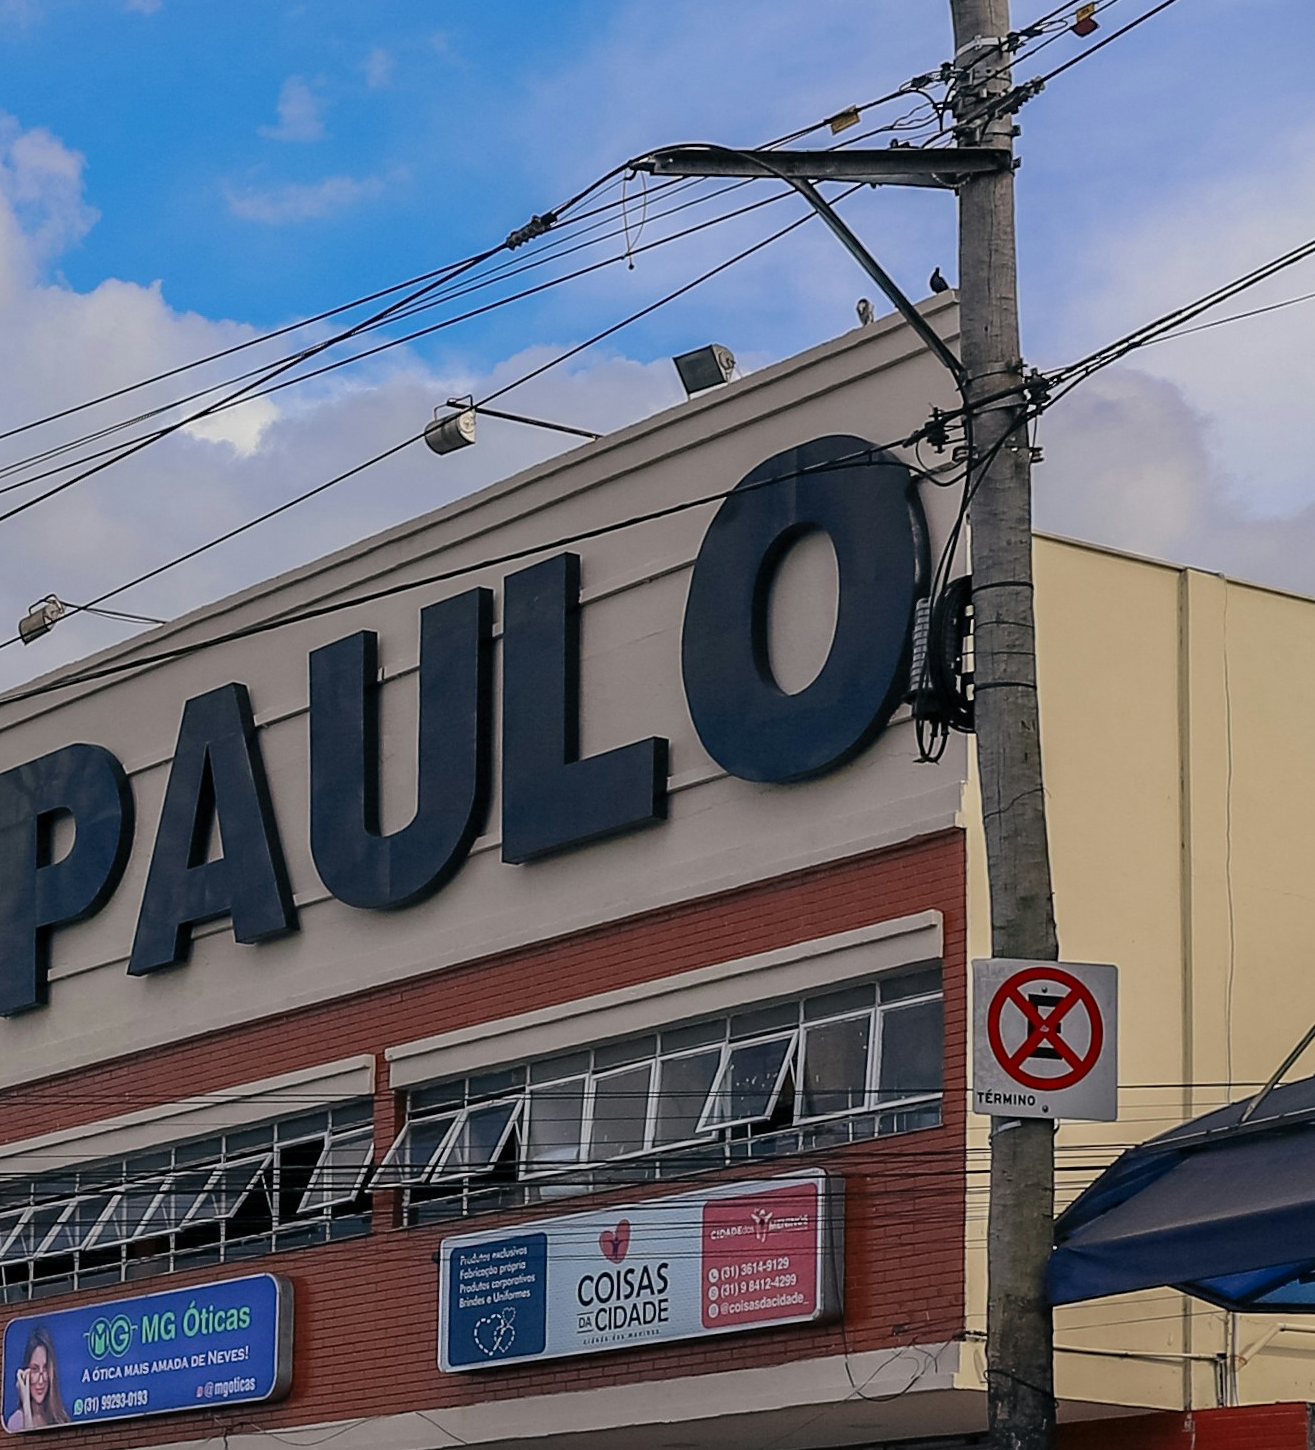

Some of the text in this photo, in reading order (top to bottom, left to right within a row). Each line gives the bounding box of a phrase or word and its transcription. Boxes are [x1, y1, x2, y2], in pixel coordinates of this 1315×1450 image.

[976, 1088, 1036, 1106] TÉRMINO
[720, 1257, 790, 1280] (31) 3614-9129
[577, 1261, 669, 1307] COISAS
[720, 1273, 797, 1298] (31) 9 8412-4299
[458, 1295, 486, 1309] Brindes
[141, 1300, 251, 1344] MG Óticas
[578, 1298, 669, 1332] DA CIDADE
[81, 1368, 91, 1383] A
[92, 1363, 123, 1381] ÓTICA
[124, 1361, 150, 1378] MAIS
[151, 1357, 189, 1373] AMADA
[190, 1354, 206, 1368] DE
[204, 1376, 256, 1399] @mgoticas
[83, 1390, 149, 1414] (31) 99293-0193
